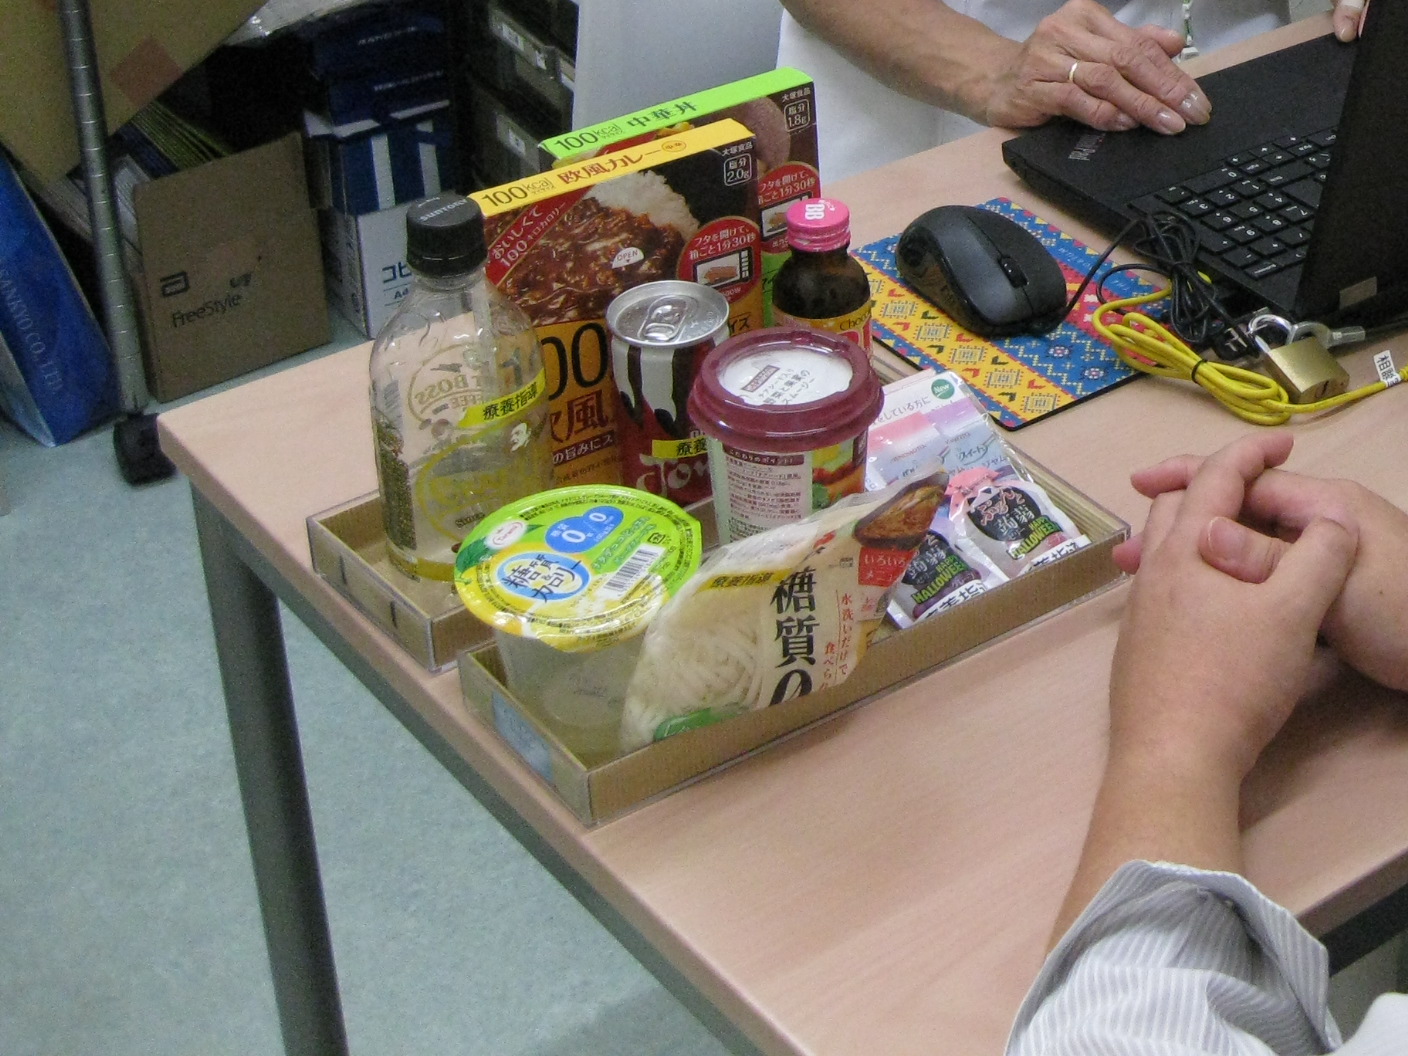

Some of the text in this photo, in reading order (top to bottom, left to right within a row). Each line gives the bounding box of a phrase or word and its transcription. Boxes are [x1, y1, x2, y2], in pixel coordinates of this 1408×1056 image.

[781, 87, 811, 103] 大塚食品
[787, 114, 807, 127] 1.8g
[788, 103, 806, 115] 塩分
[555, 101, 698, 152] 100 kcal 中華丼
[722, 141, 753, 157] 大塚食品
[728, 157, 747, 169] 塩分
[481, 186, 529, 207] 100
[522, 176, 555, 192] kcal
[556, 149, 661, 185] 欧風カレー
[726, 167, 750, 183] 2.0g
[419, 198, 468, 222] SUNTORY
[492, 204, 544, 260] おいしくて
[694, 224, 751, 247] フタを開けて、
[616, 249, 639, 262] OPEN
[689, 232, 757, 261] 箱ごと1分30秒
[172, 294, 242, 328] FreeStyle
[482, 381, 538, 421] 療養指導
[932, 383, 951, 396] New
[588, 512, 608, 522] 0
[998, 504, 1035, 534] 蒟蒻
[561, 529, 587, 543] 0
[501, 553, 560, 589] 糖質
[863, 553, 906, 569] いろいろ
[906, 544, 947, 580] 蒟蒻
[530, 560, 582, 603] カロリー
[712, 572, 775, 588] 療養指導
[838, 593, 855, 675] 水洗いだけで
